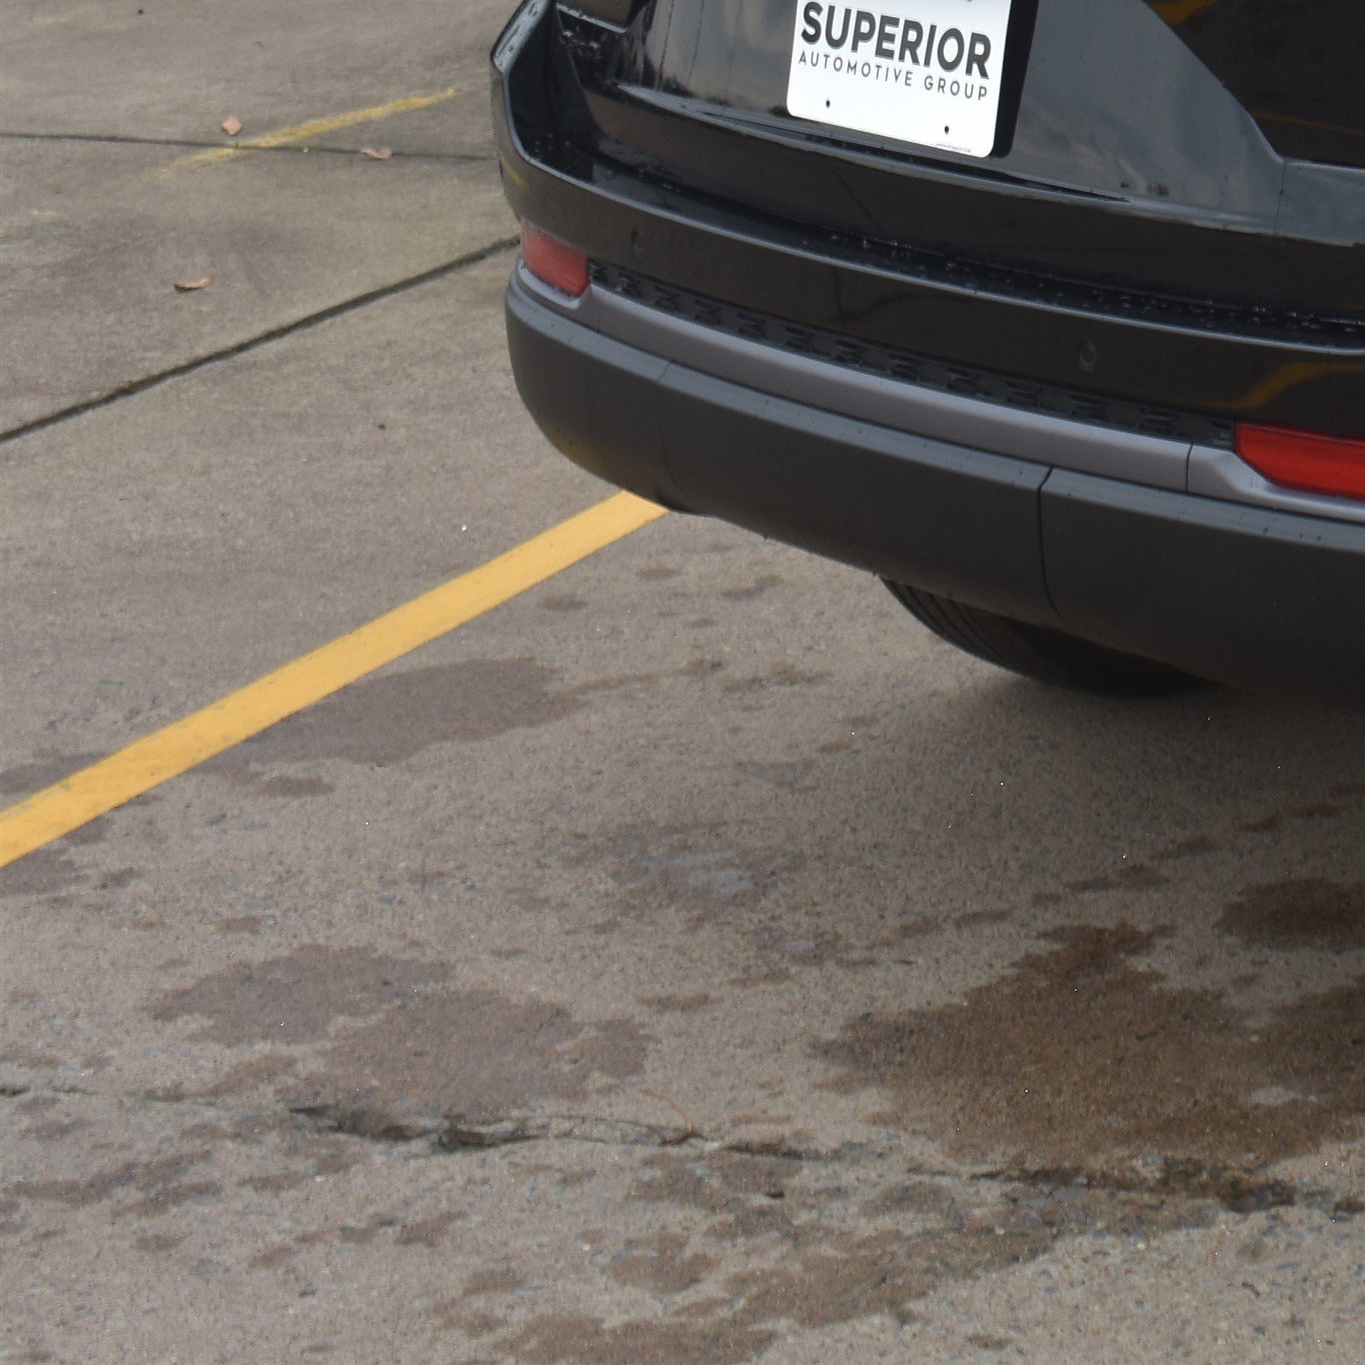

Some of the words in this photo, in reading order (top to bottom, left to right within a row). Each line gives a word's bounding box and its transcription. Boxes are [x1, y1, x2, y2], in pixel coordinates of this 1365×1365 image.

[801, 1, 992, 80] SUPERIOR
[799, 50, 914, 87] AUTOMOTIVE
[924, 75, 988, 101] GROUP
